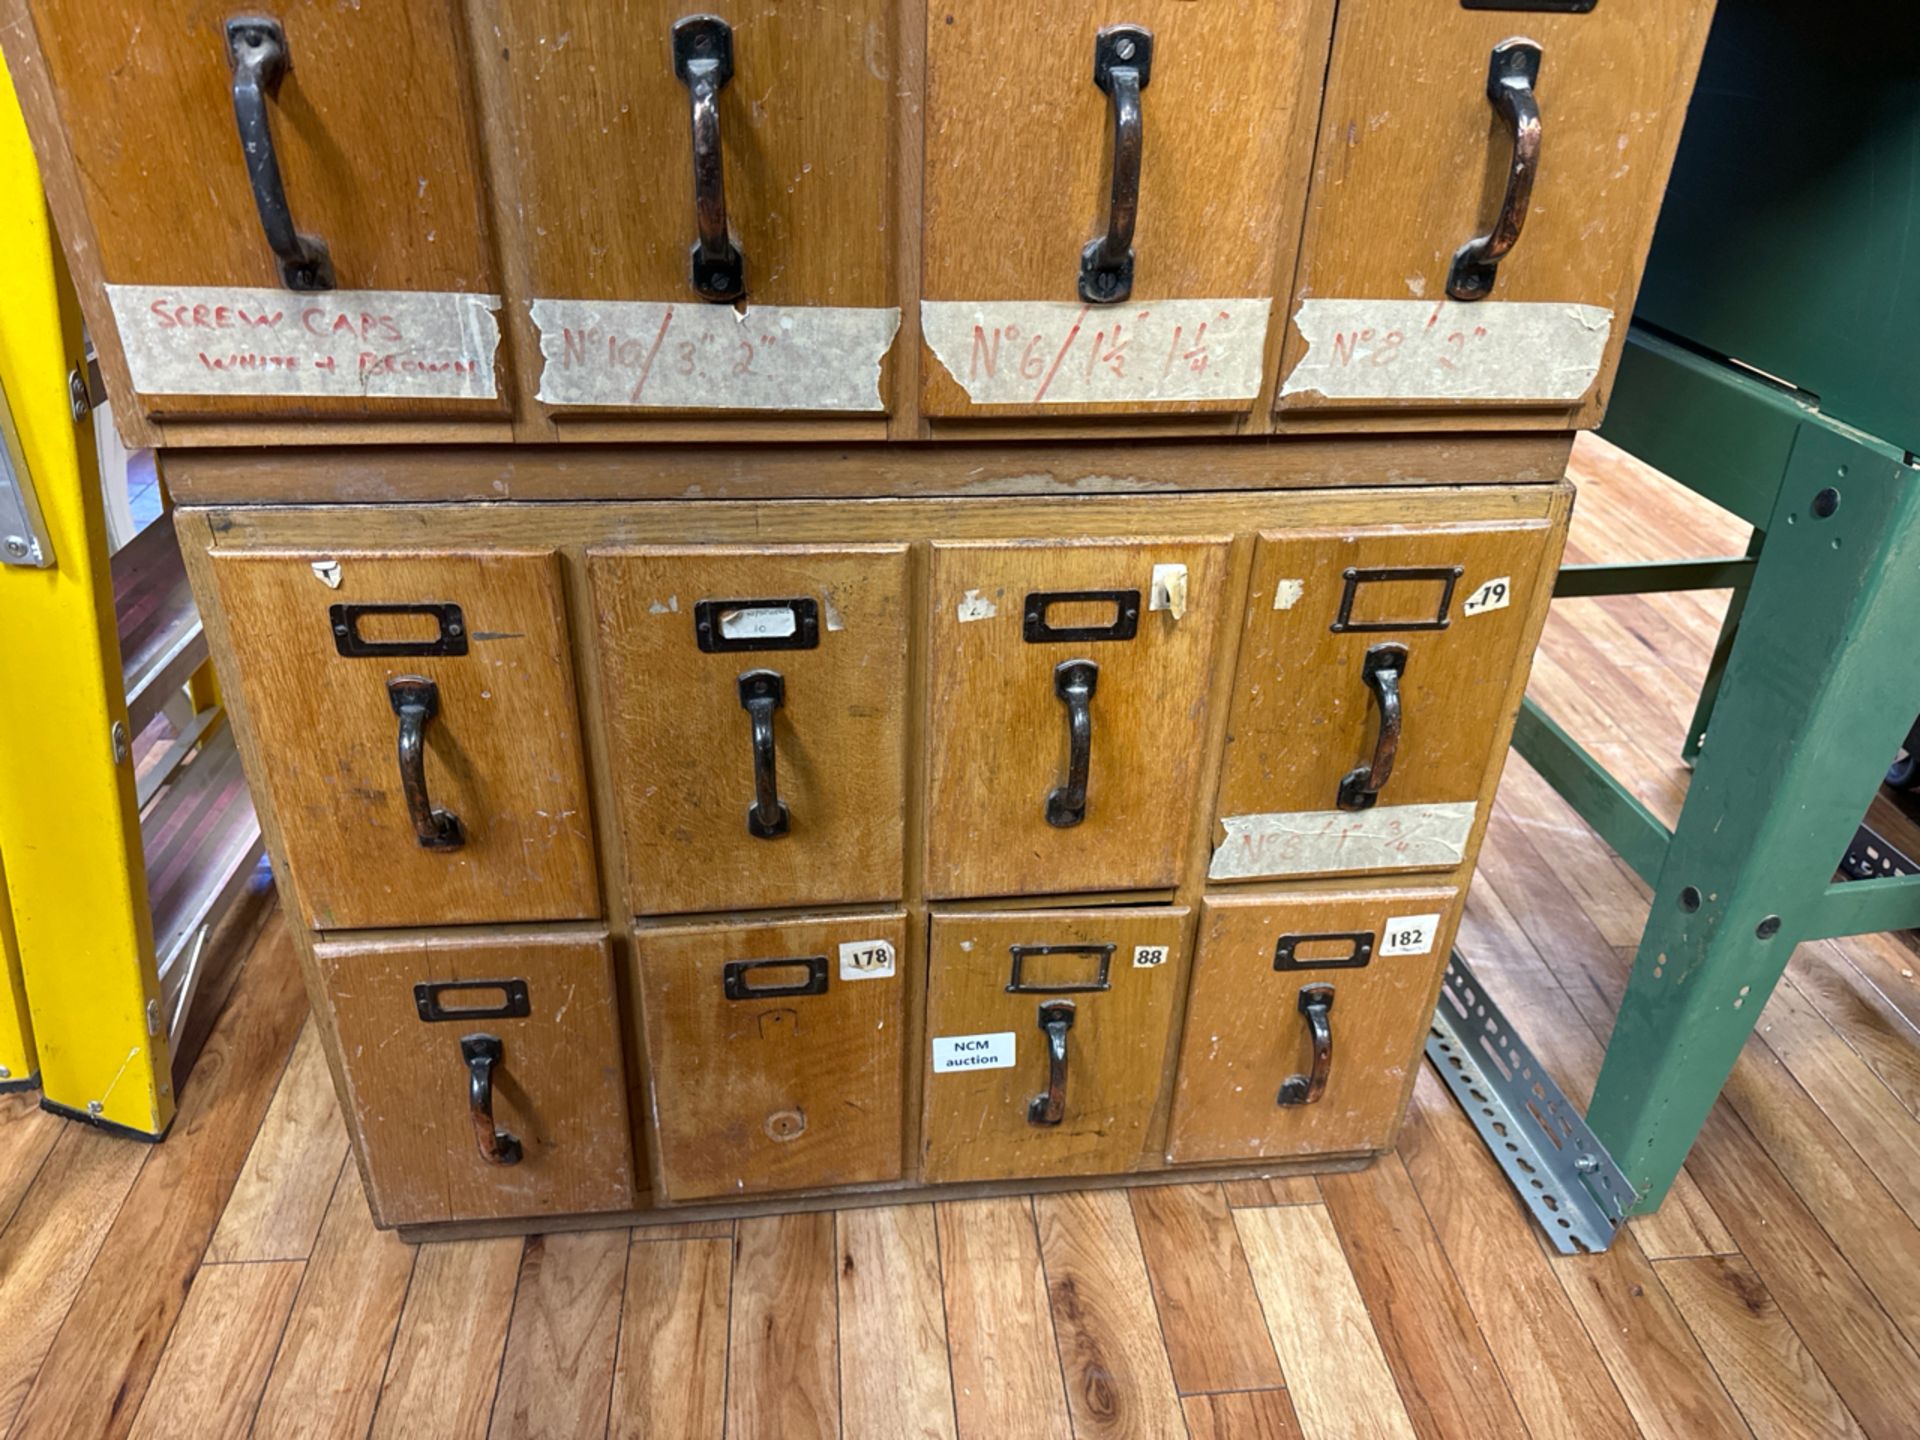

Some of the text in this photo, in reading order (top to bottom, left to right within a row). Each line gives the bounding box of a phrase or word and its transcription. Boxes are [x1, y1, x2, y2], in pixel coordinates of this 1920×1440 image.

[150, 299, 402, 342] SCREW CAPS
[1391, 929, 1423, 948] 182
[852, 948, 888, 966] 178
[1137, 949, 1162, 965] 88
[954, 1040, 990, 1052] NCM
[946, 1055, 999, 1067] auction
